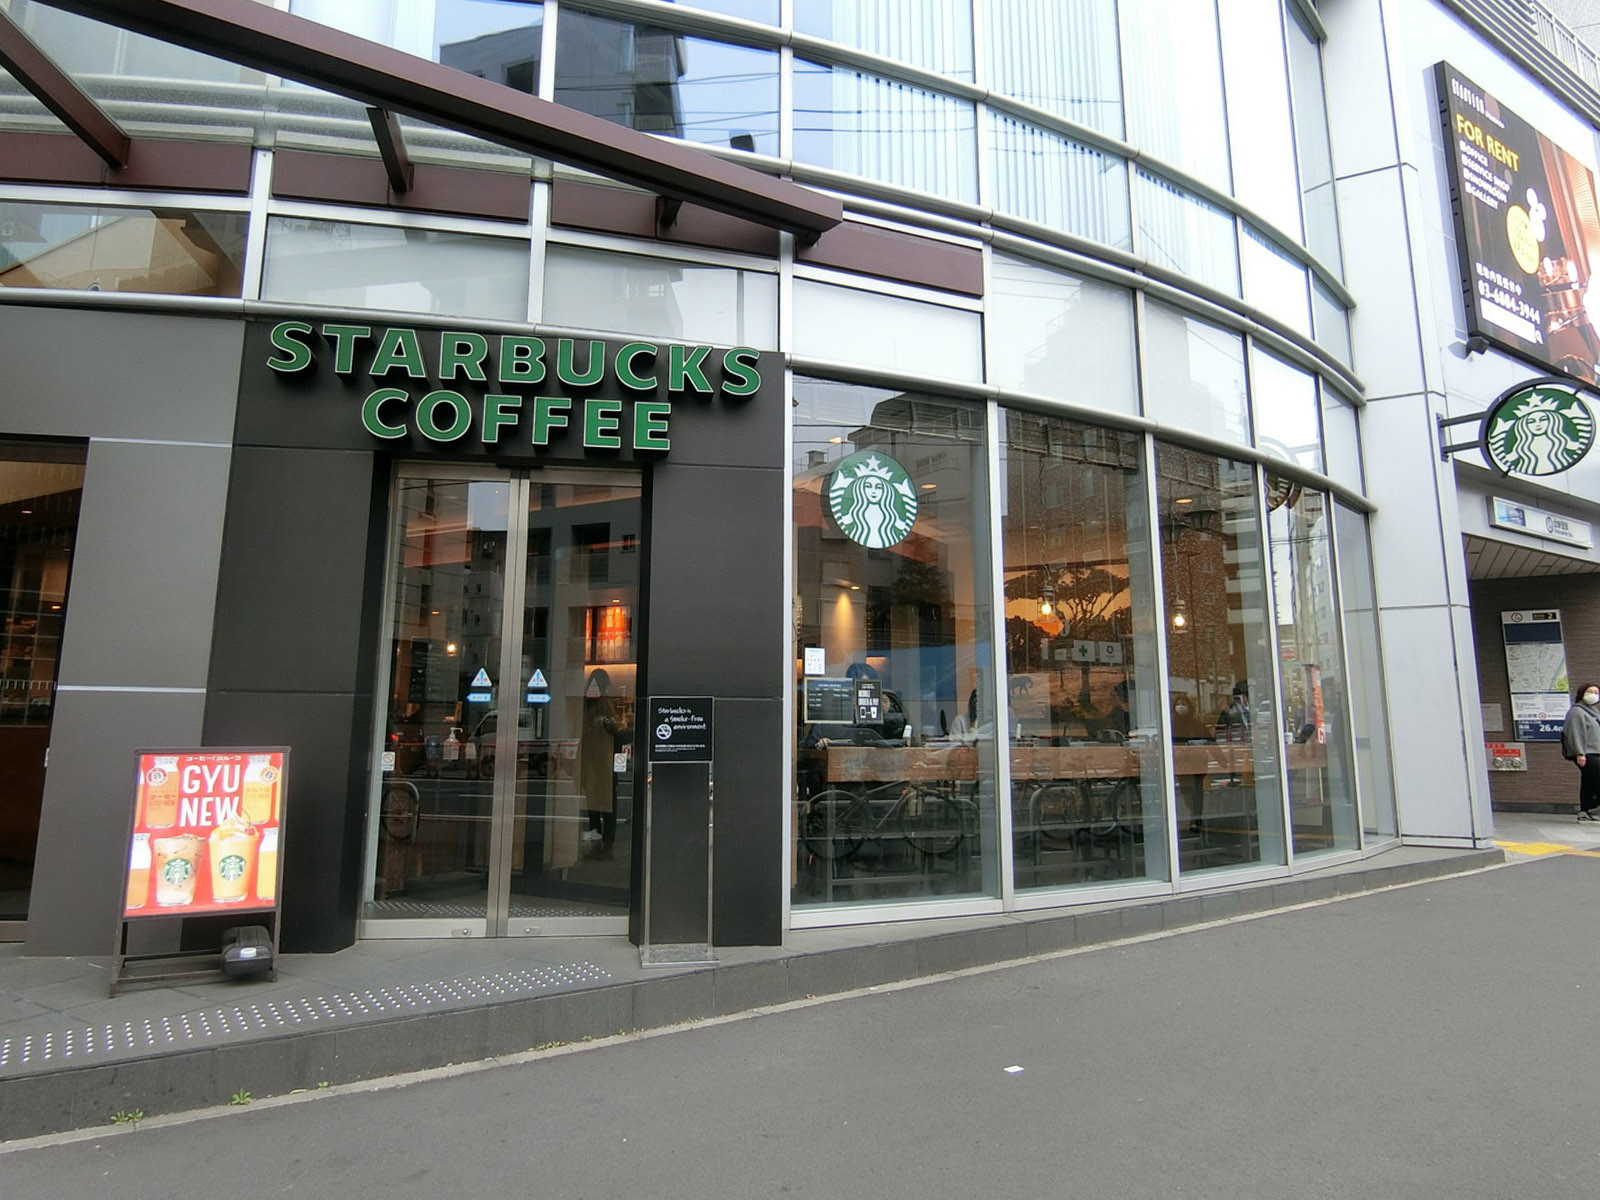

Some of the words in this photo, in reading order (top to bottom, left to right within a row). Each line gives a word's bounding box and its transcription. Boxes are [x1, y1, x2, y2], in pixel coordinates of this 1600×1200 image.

[1456, 113, 1485, 149] FOR
[1486, 134, 1520, 172] RENT
[266, 320, 762, 397] STARBUCKS
[360, 387, 672, 452] COFFEE
[183, 764, 241, 794] GYU
[179, 797, 240, 827] NEW
